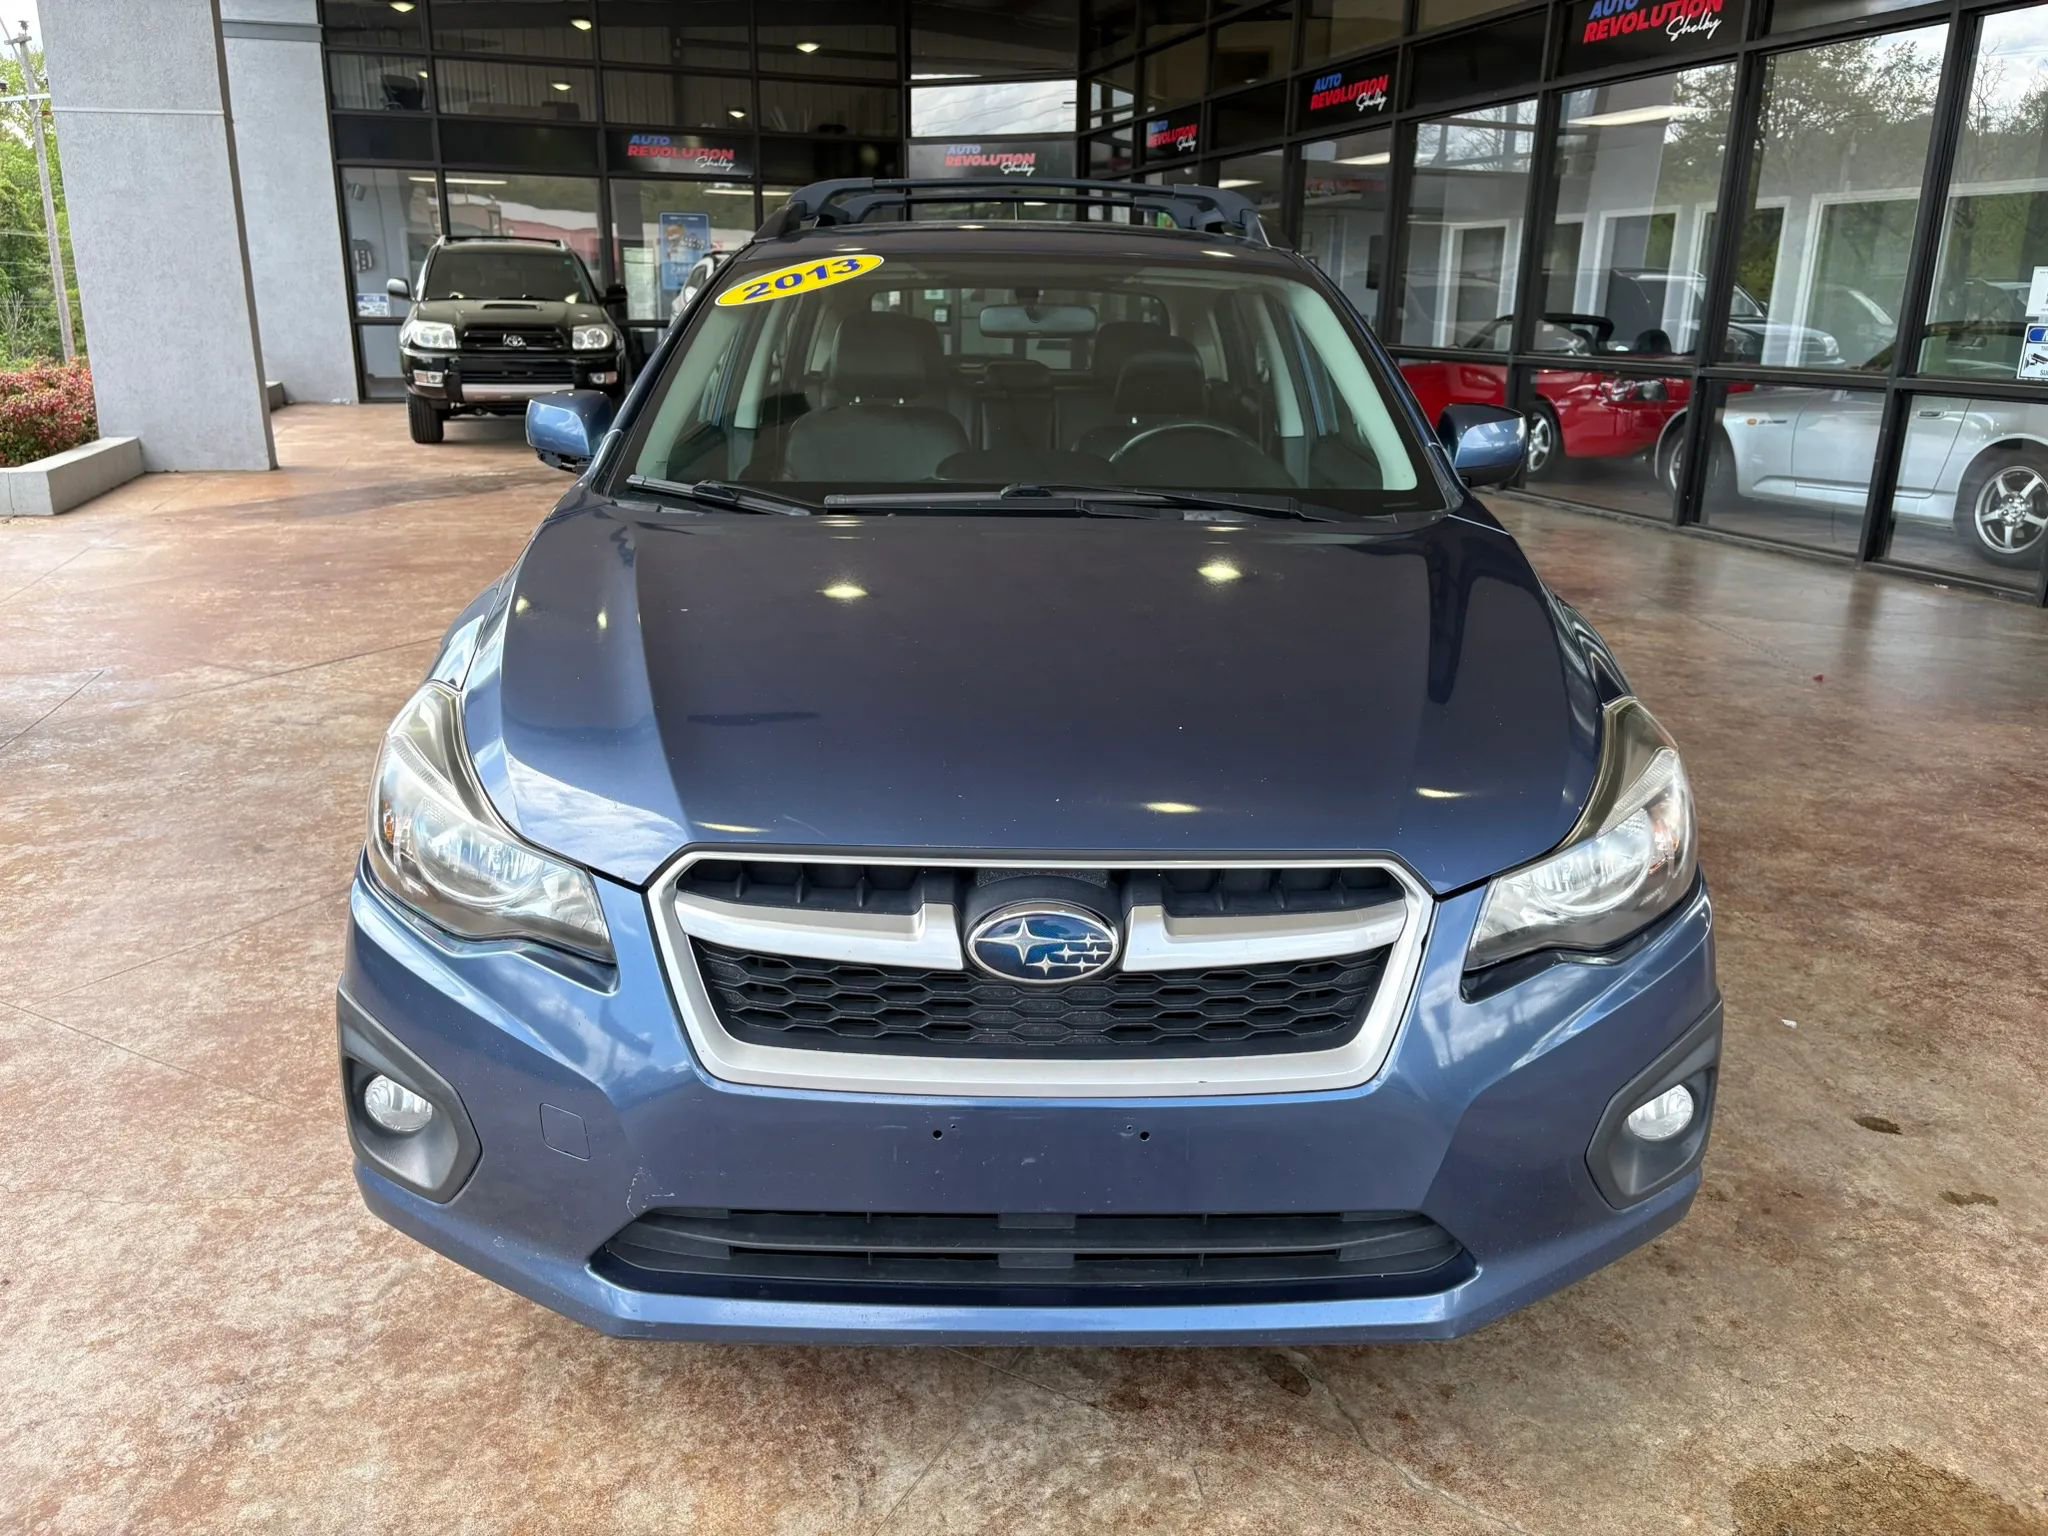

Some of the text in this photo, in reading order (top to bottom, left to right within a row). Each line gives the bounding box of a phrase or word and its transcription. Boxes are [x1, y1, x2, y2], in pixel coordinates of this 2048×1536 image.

[1588, 0, 1639, 20] AUTO
[1583, 0, 1724, 43] REVOLUTION
[1666, 8, 1722, 42] Shelby
[1311, 74, 1388, 110] REVOLUTION
[1313, 72, 1342, 92] AUTO
[1356, 88, 1388, 112] Shelby
[629, 134, 671, 145] AUTO
[947, 144, 981, 155] AUTO
[627, 145, 735, 160] REVOLUTION
[945, 153, 1036, 167] REVOLUTION
[695, 156, 735, 171] Shelby
[1000, 161, 1035, 177] Shelby
[743, 259, 863, 301] 2013
